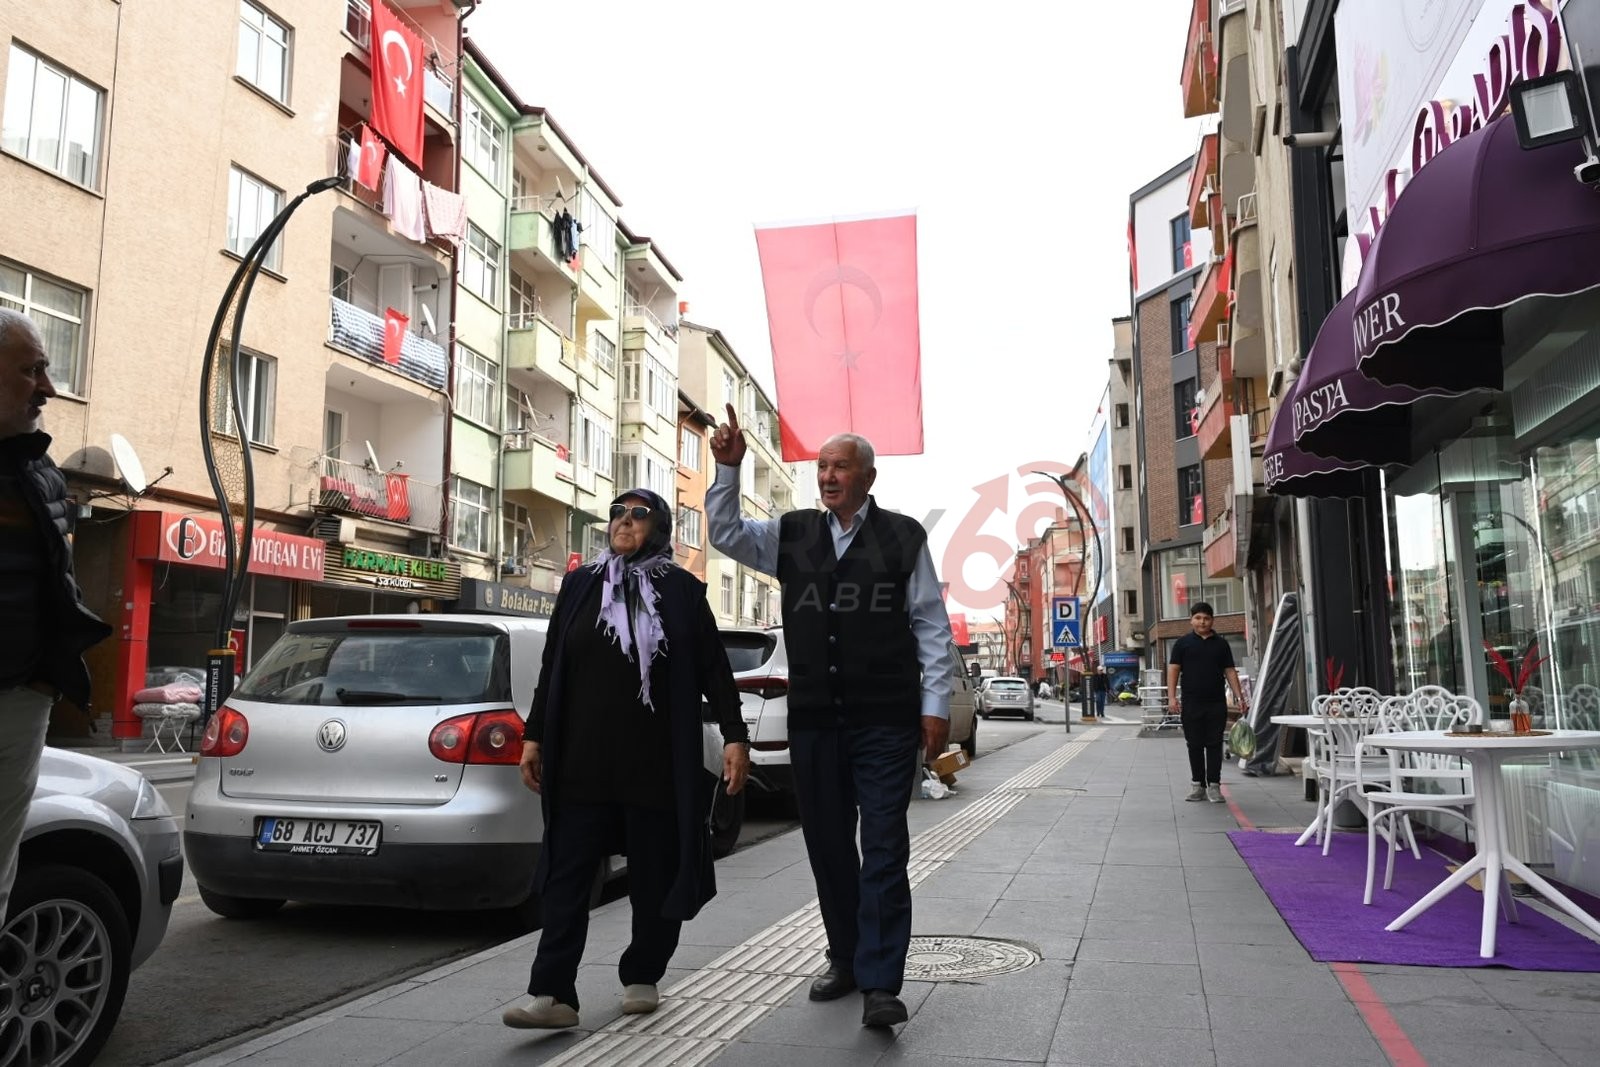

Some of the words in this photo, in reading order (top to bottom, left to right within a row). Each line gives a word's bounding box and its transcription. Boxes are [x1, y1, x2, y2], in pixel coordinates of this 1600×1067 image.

[1295, 378, 1350, 431] PASTA
[252, 537, 299, 568] YORGAN
[344, 549, 407, 575] HARMAN
[501, 588, 539, 613] Bolakar
[539, 596, 556, 615] Per
[1060, 602, 1073, 618] D
[272, 820, 295, 841] 68
[302, 821, 337, 843] ACJ
[344, 823, 379, 846] 737
[290, 845, 315, 853] AHMET
